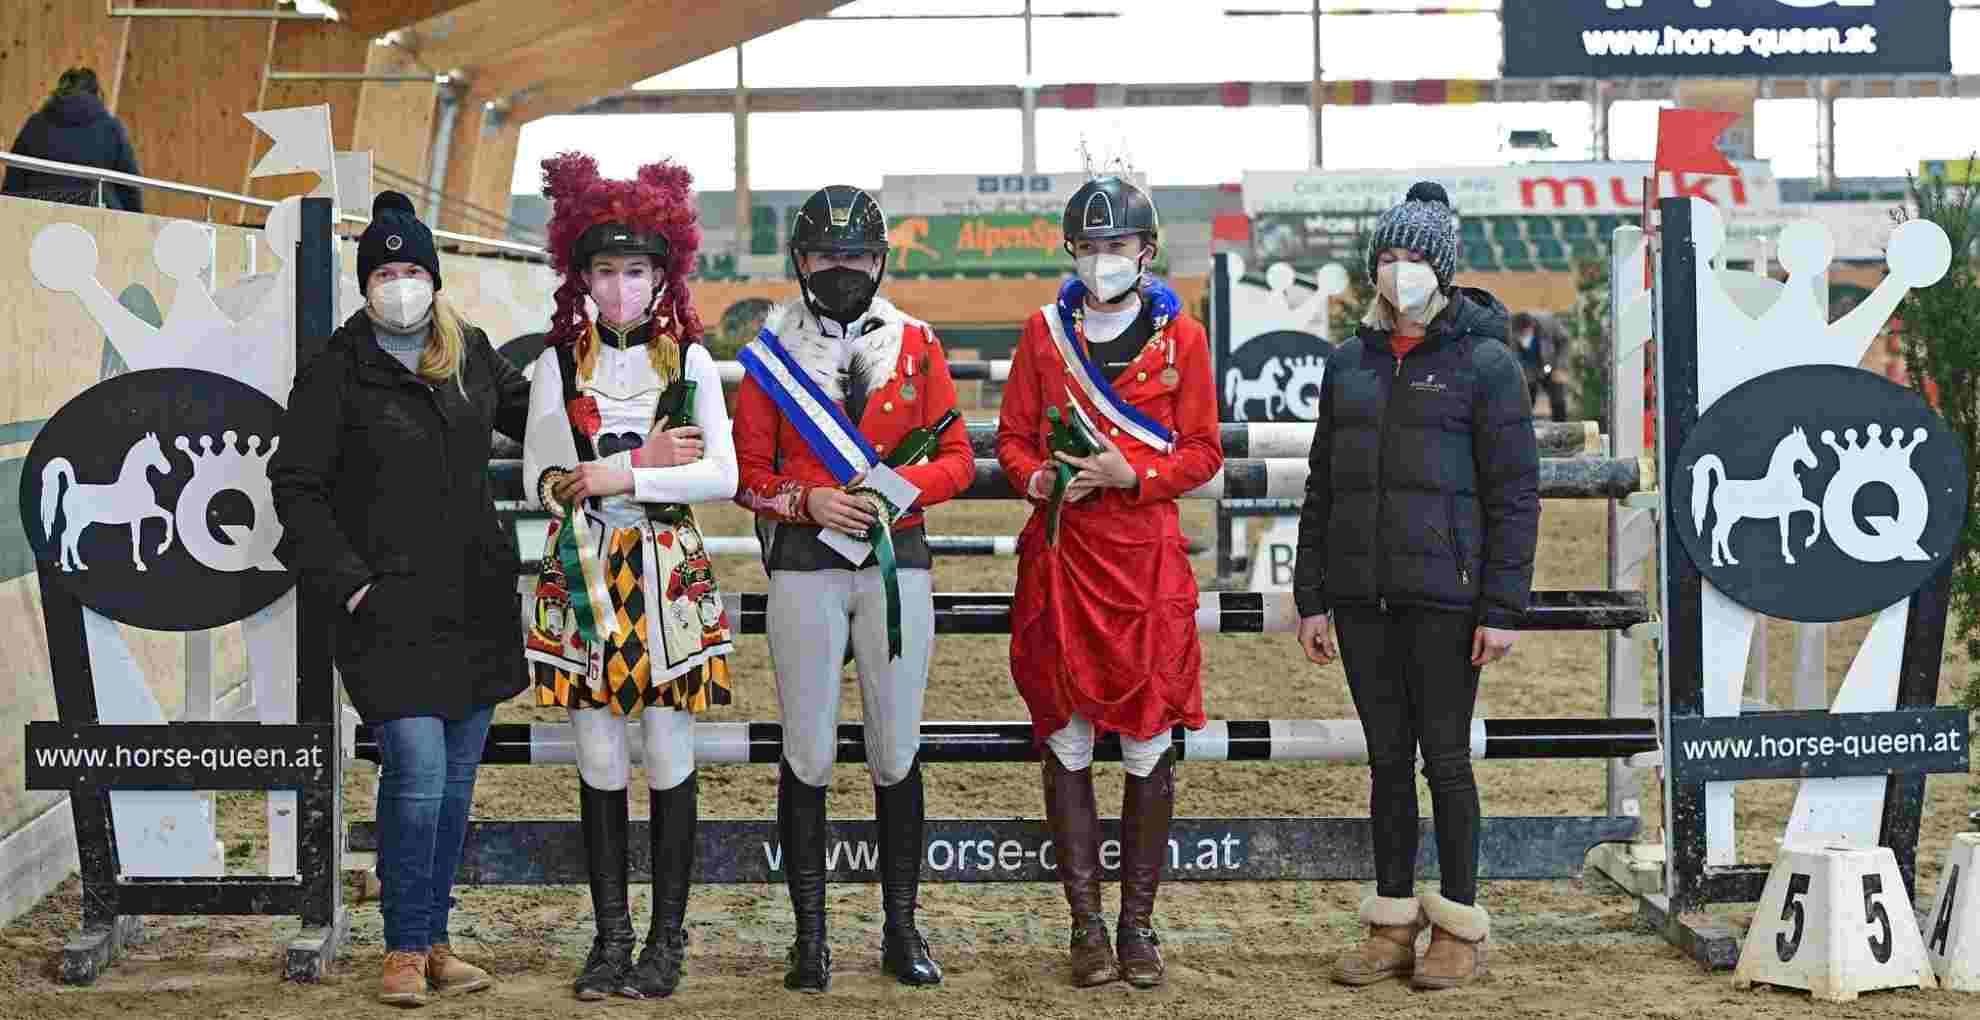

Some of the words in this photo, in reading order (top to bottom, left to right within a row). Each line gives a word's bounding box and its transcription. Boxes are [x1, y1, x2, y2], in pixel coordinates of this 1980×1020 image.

[1582, 25, 1877, 58] www.horse-queen.at
[1519, 173, 1749, 209] muki
[1822, 447, 1933, 563] Q
[1271, 544, 1294, 586] B
[35, 743, 324, 770] www.horse-queen.at
[1682, 729, 1961, 761] www.horse-queen.at
[1775, 873, 1811, 963] 5
[1861, 873, 1893, 964] 5
